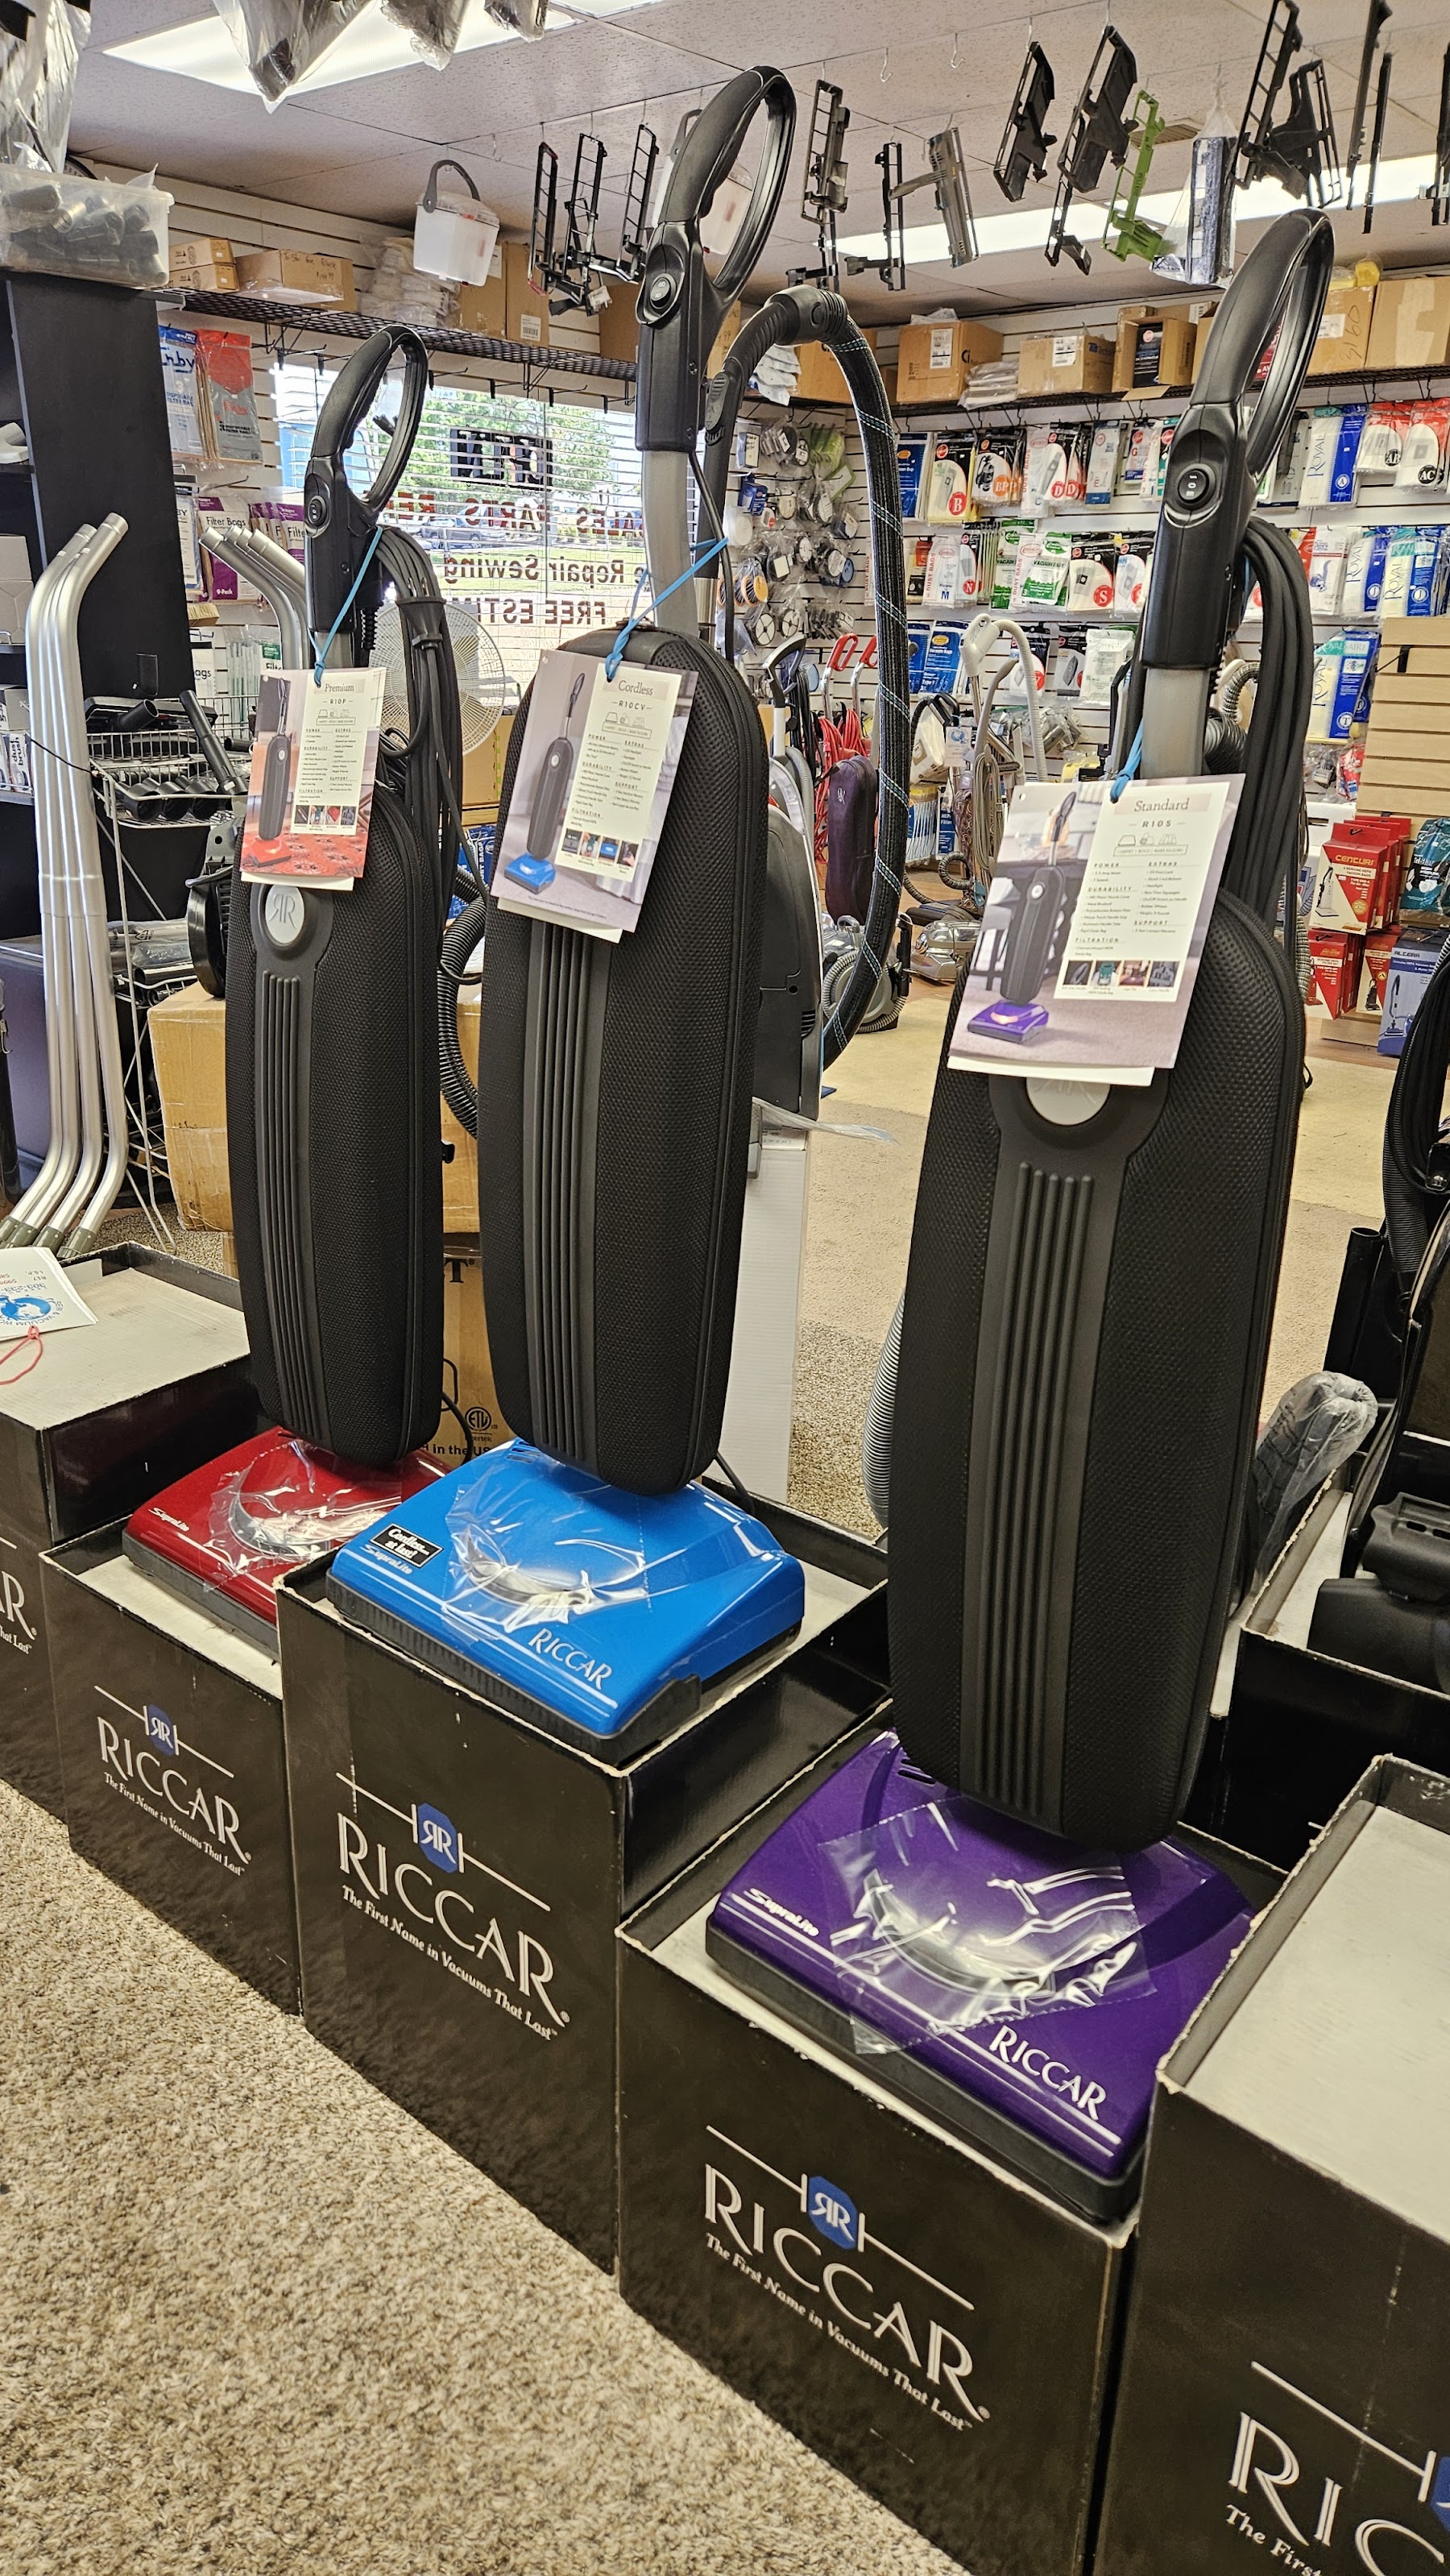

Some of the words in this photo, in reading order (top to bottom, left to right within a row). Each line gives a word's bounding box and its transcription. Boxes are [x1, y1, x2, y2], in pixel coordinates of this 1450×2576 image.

[1307, 432, 1327, 478] ROYAL
[1386, 452, 1401, 465] AB
[1420, 469, 1436, 481] AC
[995, 481, 1009, 492] BP
[1054, 485, 1062, 496] D
[1067, 483, 1075, 494] D
[953, 498, 963, 513] B
[206, 516, 225, 526] Filter
[227, 517, 246, 528] Bags
[288, 526, 304, 538] Filte
[1345, 545, 1364, 583] ROYAL
[1384, 558, 1404, 600] ROYAL
[941, 591, 950, 600] M
[967, 583, 974, 593] N
[1099, 590, 1108, 604] S
[1349, 643, 1368, 651] AIRE
[195, 670, 212, 680] ags
[324, 683, 354, 692] Premium
[618, 680, 653, 696] Cordless
[588, 733, 607, 741] POWER
[15, 736, 23, 765] brush
[615, 782, 638, 790] SUPPORT
[1134, 797, 1190, 812] Standard
[433, 1444, 445, 1454] in
[449, 1445, 468, 1455] the
[147, 1507, 191, 1533] SupraLite
[385, 1538, 398, 1549] at
[359, 1544, 412, 1575] SupraLite
[0, 1624, 12, 1644] hat
[13, 1634, 30, 1655] Last
[528, 1627, 613, 1691] RICCAR
[97, 1716, 249, 1865] RICCAR
[104, 1771, 119, 1791] The
[120, 1780, 135, 1804] First
[136, 1794, 160, 1819] Name
[160, 1811, 168, 1826] in
[168, 1818, 202, 1850] Vacuums
[203, 1840, 222, 1863] That
[224, 1852, 242, 1877] Last
[337, 1812, 566, 2028] RICCAR
[744, 1888, 820, 1937] SupraLite
[342, 1884, 362, 1910] The
[365, 1897, 389, 1928] First
[390, 1917, 425, 1952] Name
[427, 1941, 439, 1961] in
[441, 1950, 492, 1998] Vacuums
[493, 1988, 523, 2022] That
[524, 2010, 552, 2041] Last
[988, 2023, 1108, 2122] RICCAR
[705, 2163, 984, 2423] RICCAR
[705, 2232, 731, 2261] The
[732, 2252, 763, 2284] First
[764, 2275, 806, 2316] Name
[808, 2308, 823, 2329] in
[826, 2320, 889, 2378] Vacuums
[893, 2367, 928, 2405] That
[930, 2398, 963, 2431] Last
[1225, 2503, 1266, 2545] The
